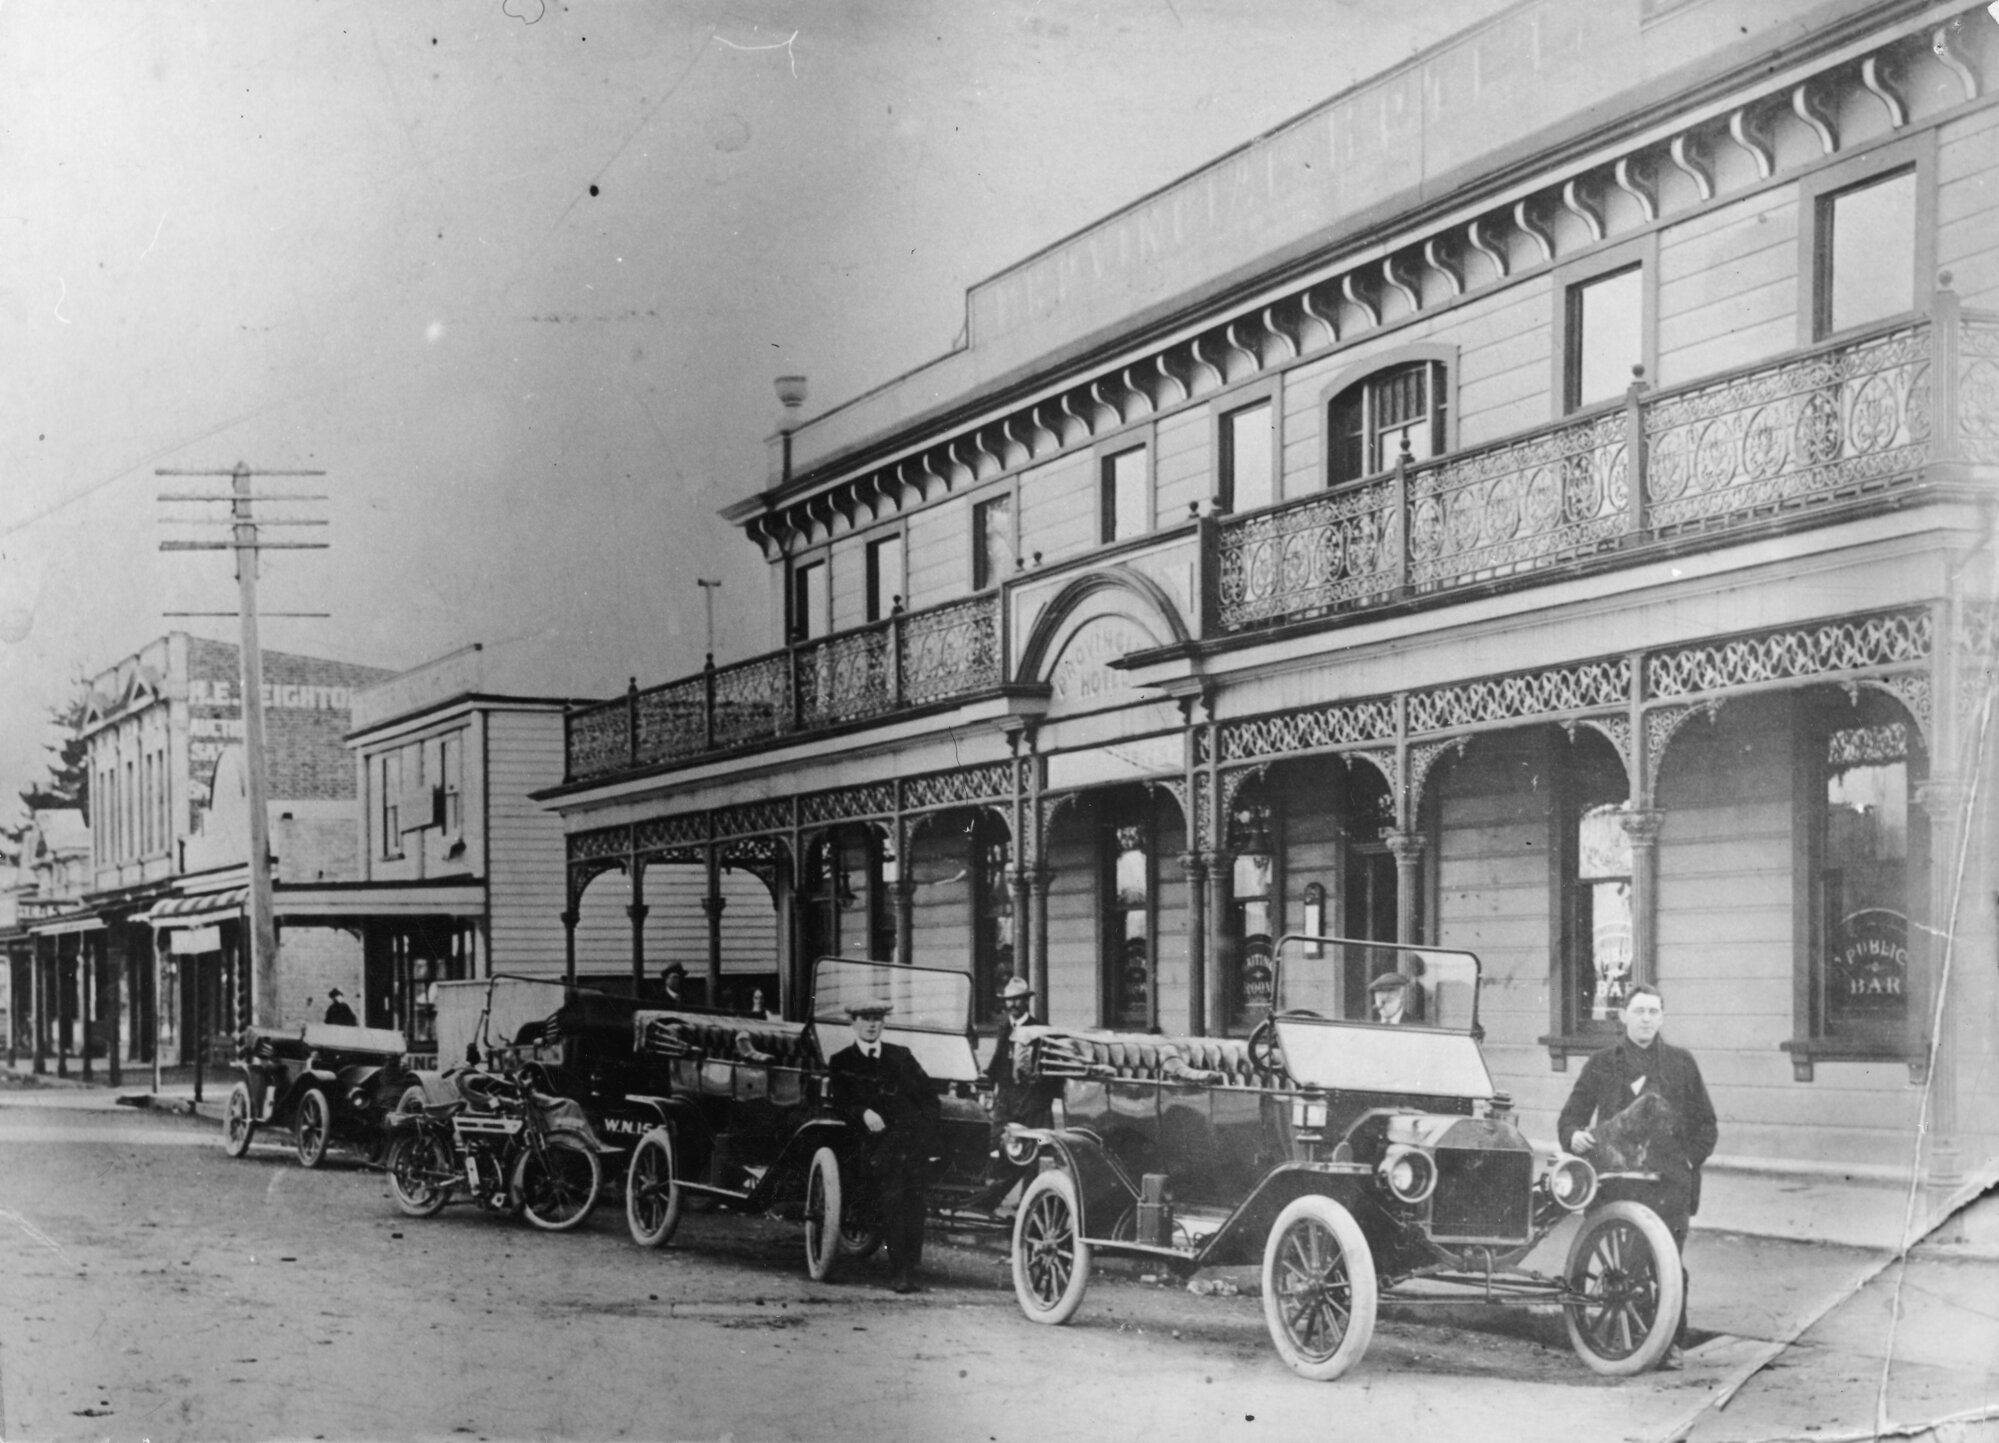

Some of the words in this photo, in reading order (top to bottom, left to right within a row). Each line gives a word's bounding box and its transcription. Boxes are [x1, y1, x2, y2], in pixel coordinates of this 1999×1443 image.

[1080, 668, 1132, 696] HOTEL
[260, 684, 353, 709] EIGHTO
[1845, 939, 1909, 966] PUBLIC
[1850, 977, 1901, 994] BAR
